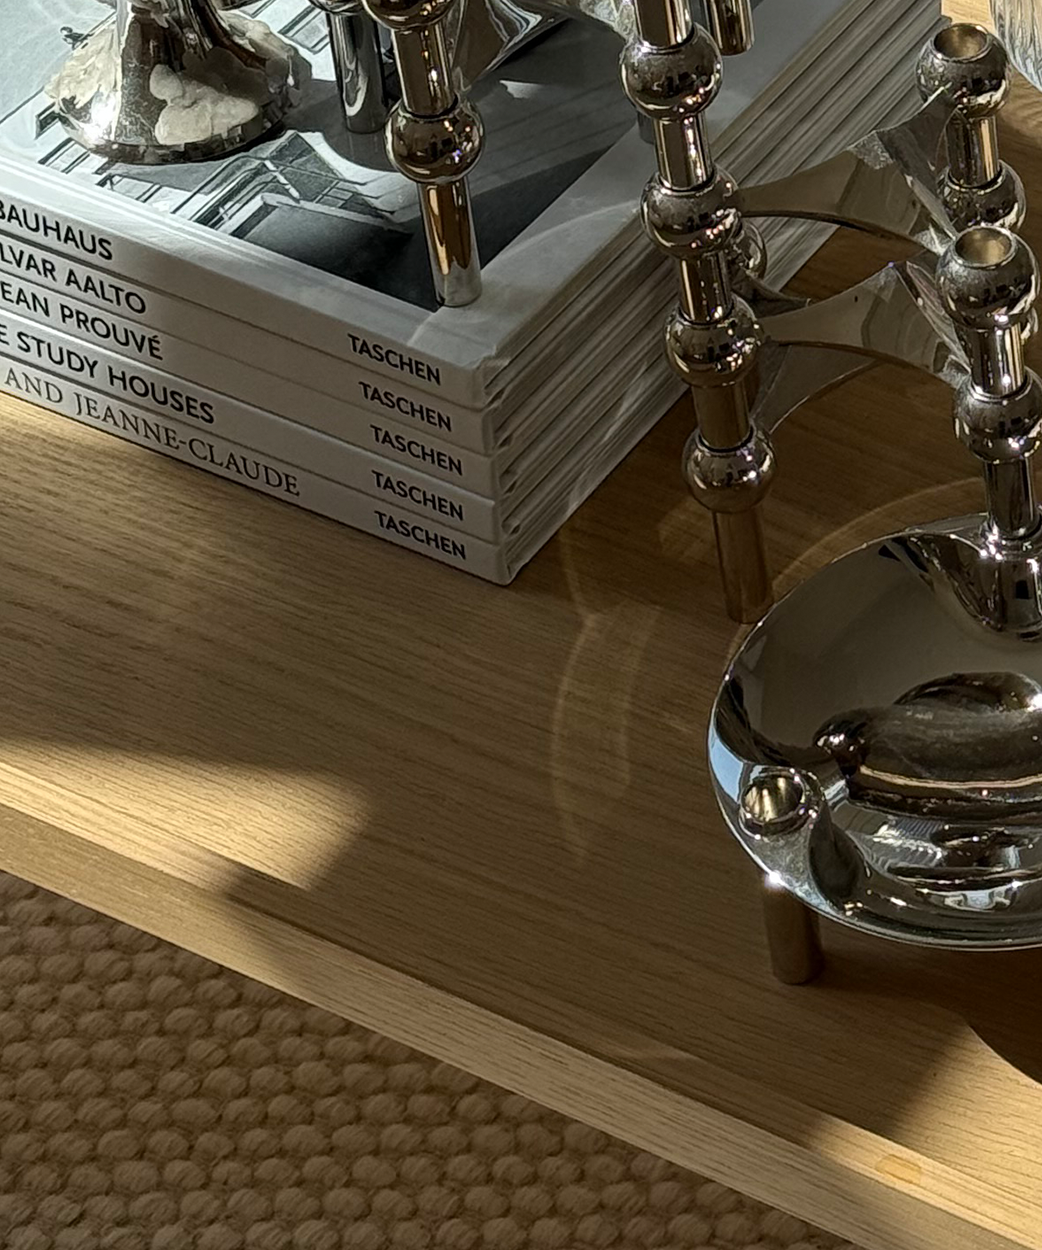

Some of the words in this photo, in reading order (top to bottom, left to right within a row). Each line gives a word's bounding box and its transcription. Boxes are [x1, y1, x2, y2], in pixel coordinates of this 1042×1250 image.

[65, 268, 146, 314] AALTO
[59, 302, 163, 360] PROUVÉ
[17, 331, 98, 378] STUDY
[108, 365, 215, 425] HOUSES
[348, 333, 441, 385] TASCHEN
[4, 367, 63, 403] AND
[73, 391, 300, 497] JEANNE-CLAUDE
[358, 381, 452, 432] TASCHEN
[370, 424, 463, 476] TASCHEN
[371, 469, 463, 521] TASCHEN
[374, 510, 466, 560] TASCHEN
